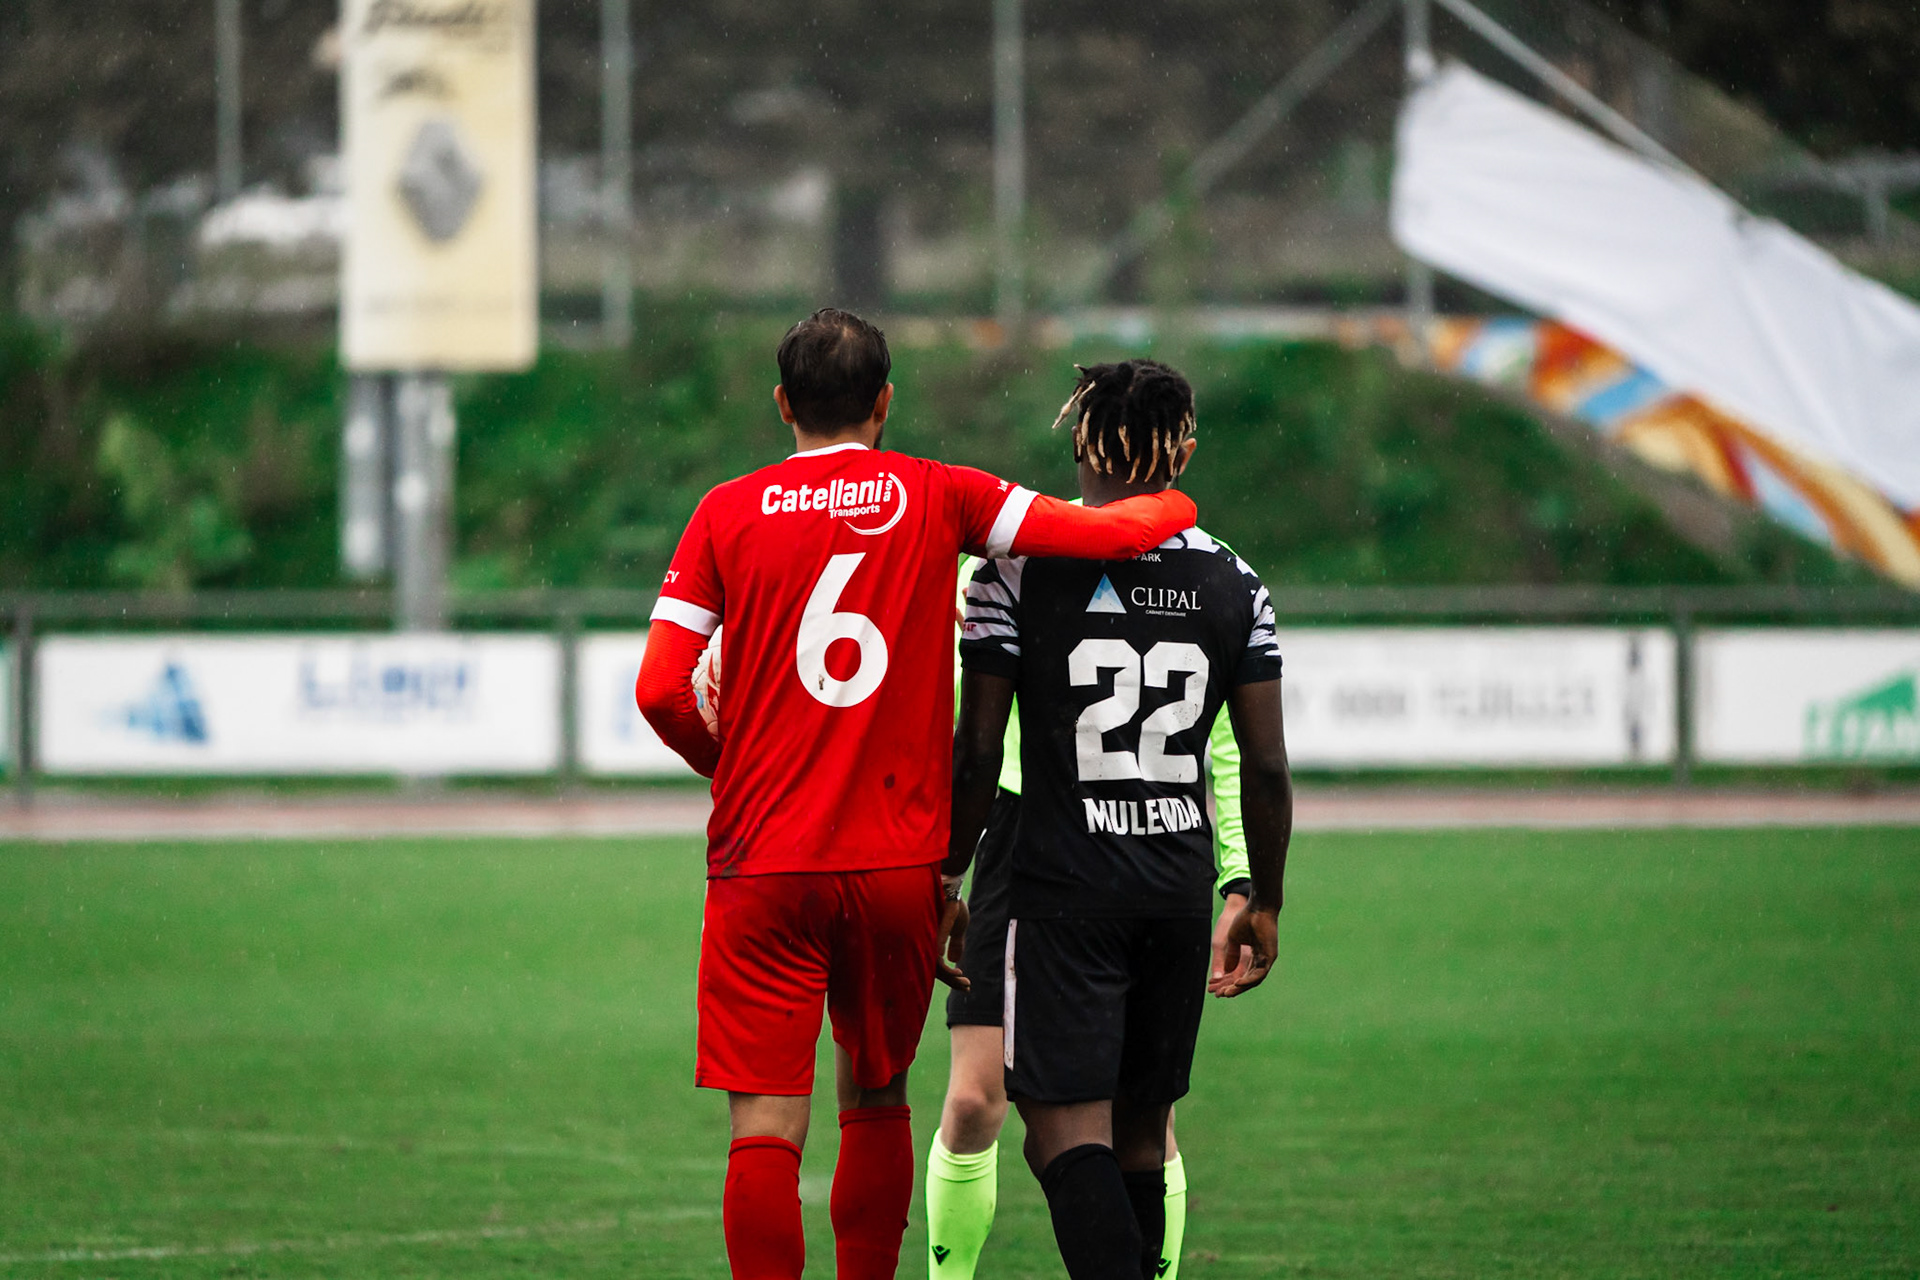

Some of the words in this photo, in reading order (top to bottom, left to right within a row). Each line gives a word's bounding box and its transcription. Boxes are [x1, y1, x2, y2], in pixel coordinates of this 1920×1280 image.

[761, 472, 884, 515] Catellani
[828, 504, 880, 519] Transports
[1131, 587, 1202, 610] CLIPAL
[796, 552, 889, 708] 6
[1068, 638, 1210, 783] 22
[1082, 795, 1202, 835] MULENDA
